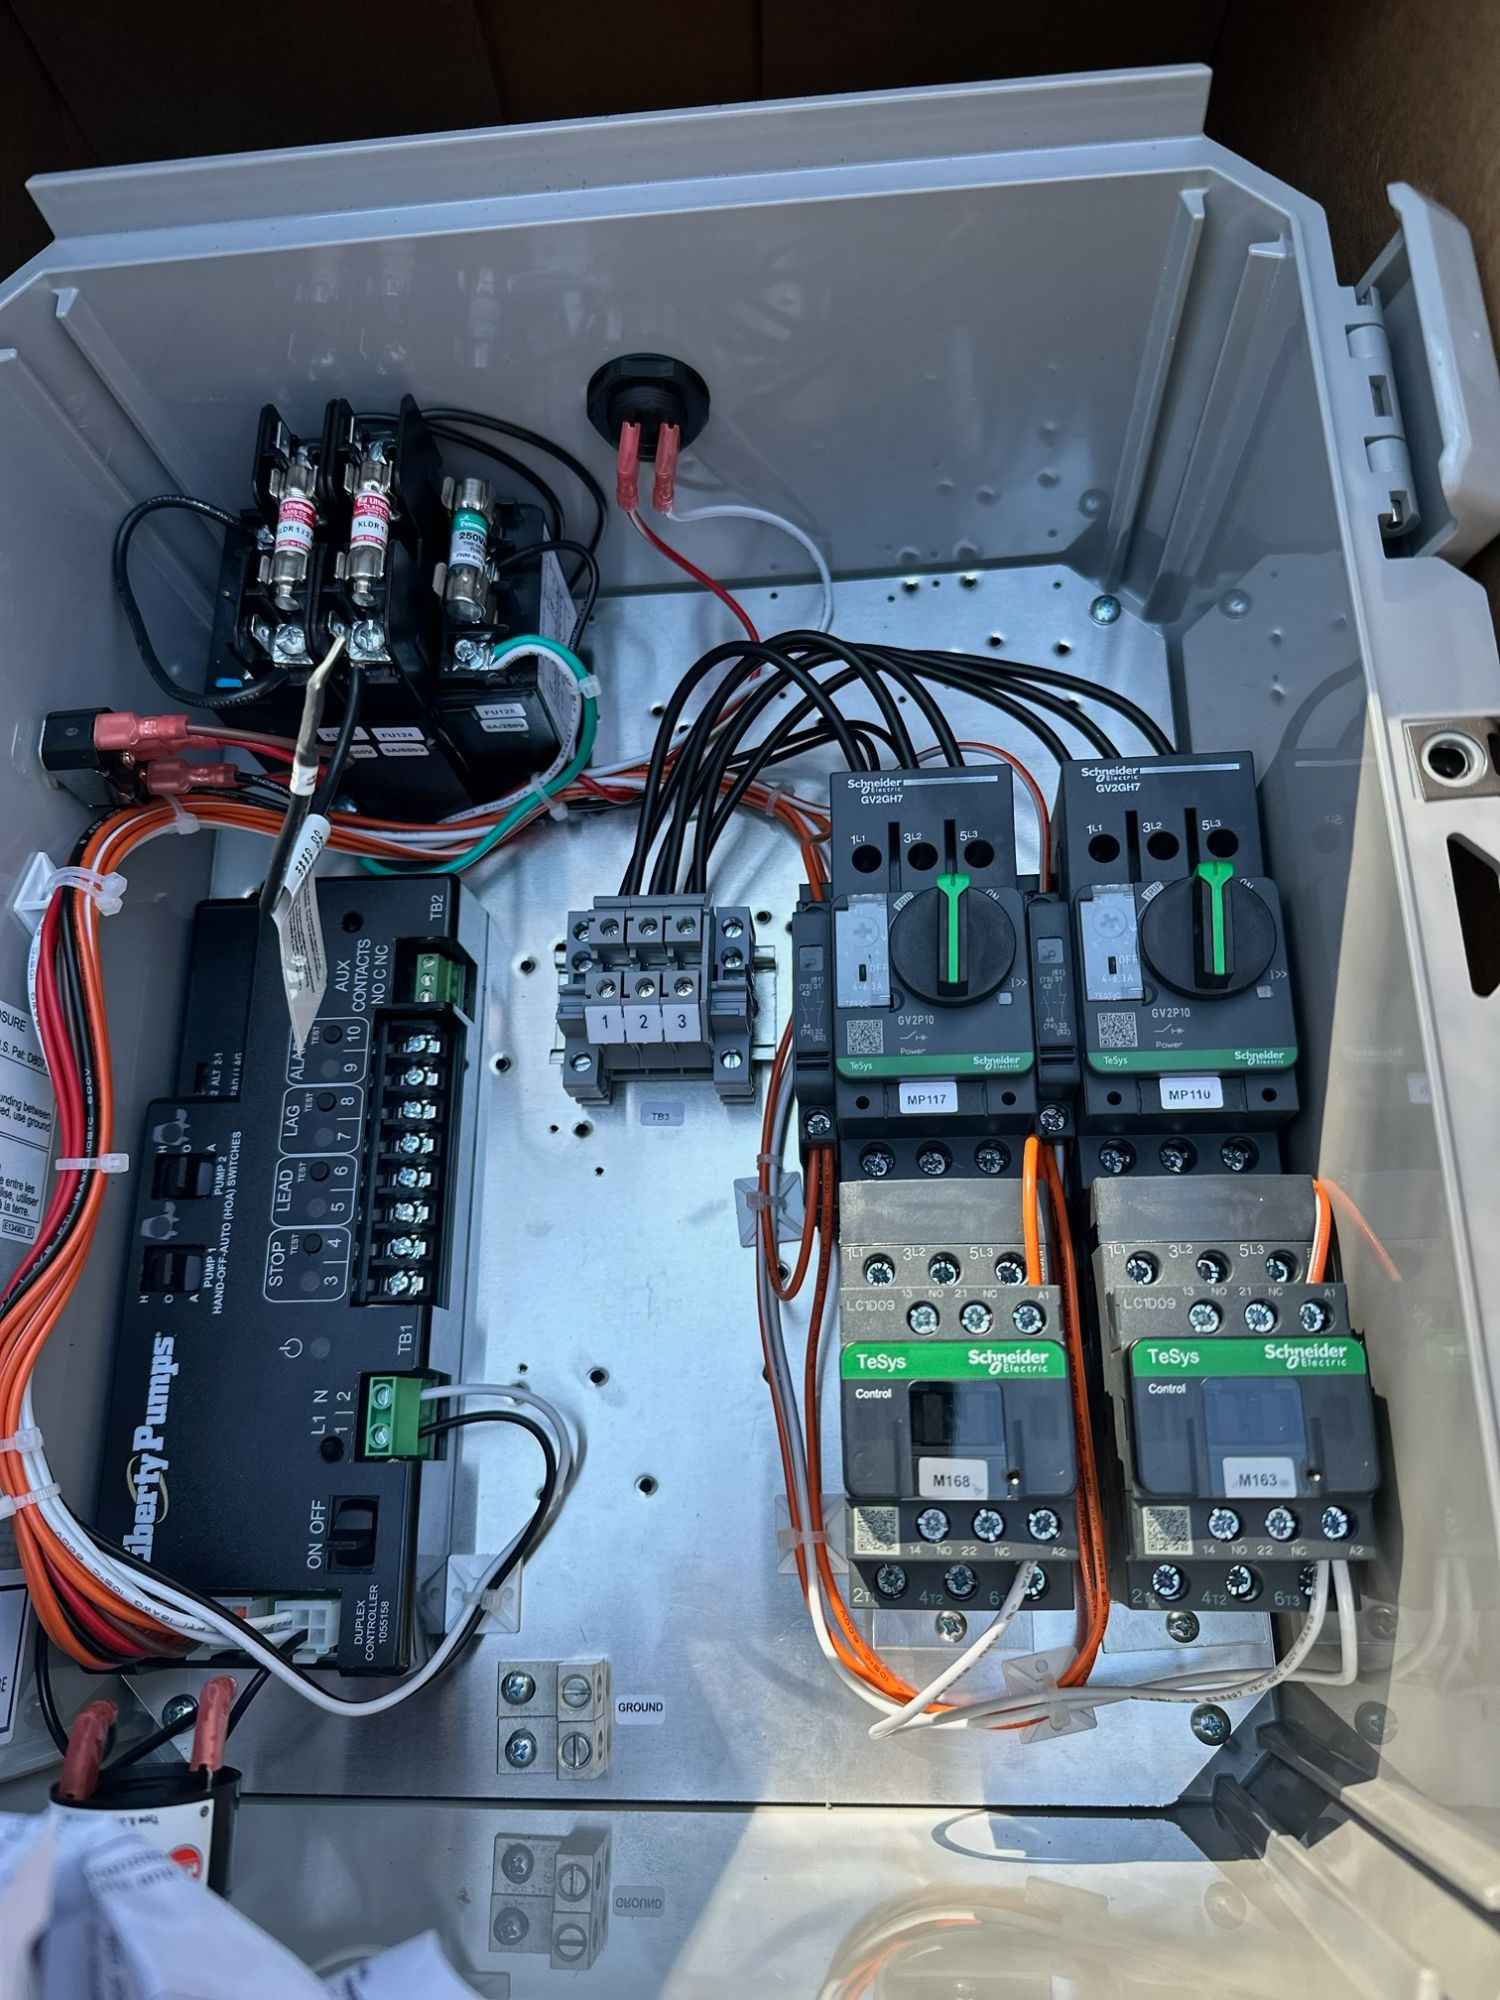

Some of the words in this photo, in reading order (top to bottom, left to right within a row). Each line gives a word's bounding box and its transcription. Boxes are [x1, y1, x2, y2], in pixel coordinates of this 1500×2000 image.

[1081, 766, 1138, 780] Schneider
[848, 779, 902, 792] Schneider
[1096, 783, 1141, 793] GV2GH7
[861, 794, 903, 804] GV2GH7
[1143, 882, 1163, 899] TRIP
[430, 895, 443, 921] TB2
[380, 945, 389, 970] NC
[335, 959, 351, 992] AUX
[352, 938, 371, 1012] CONTACTS
[379, 970, 387, 982] C
[371, 982, 385, 1004] NO
[1152, 1008, 1190, 1018] GV2P10
[0, 1010, 26, 1032] SURE
[602, 1015, 608, 1028] 1
[639, 1015, 648, 1028] 2
[678, 1015, 686, 1028] 3
[898, 1016, 935, 1025] GV2P10
[312, 1026, 320, 1045] TEST
[347, 1026, 360, 1042] 10
[973, 1056, 1020, 1068] Schneider
[1104, 1056, 1128, 1066] TeSys
[1235, 1050, 1284, 1062] Schneider
[344, 1063, 357, 1072] 9
[850, 1062, 872, 1071] TeSys
[212, 1070, 221, 1086] ALT
[305, 1092, 314, 1112] TEST
[341, 1096, 354, 1106] 8
[907, 1094, 946, 1105] MP117
[284, 1105, 300, 1136] LAG
[651, 1112, 670, 1121] TB3
[337, 1132, 351, 1141] 7
[183, 1144, 191, 1153] O
[207, 1144, 217, 1152] A
[227, 1131, 242, 1187] SWITCHES
[298, 1161, 307, 1182] TEST
[334, 1166, 348, 1176] 6
[214, 1165, 225, 1196] PUMP
[276, 1169, 293, 1212] LEAD
[224, 1190, 234, 1220] (HOA)
[331, 1202, 345, 1212] 5
[290, 1233, 300, 1255] TEST
[328, 1238, 341, 1247] 4
[212, 1221, 231, 1315] HAND-OFF-AUTO
[269, 1241, 285, 1287] STOP
[204, 1255, 216, 1288] PUMP
[324, 1276, 337, 1286] 3
[164, 1295, 173, 1303] O
[189, 1294, 199, 1303] A
[398, 1324, 412, 1355] TB1
[1147, 1349, 1200, 1367] TeSys
[1264, 1343, 1347, 1360] Schneider
[857, 1354, 906, 1372] TeSys
[968, 1350, 1049, 1367] Schneider
[1301, 1358, 1347, 1367] Electric
[1003, 1362, 1048, 1372] Electric
[132, 1335, 179, 1452] Pumps
[855, 1388, 892, 1399] Control
[1148, 1383, 1186, 1394] Control
[314, 1390, 328, 1403] N
[337, 1390, 351, 1401] 2
[312, 1415, 325, 1435] L1
[335, 1425, 348, 1434] 1
[933, 1475, 970, 1487] M168
[1239, 1474, 1277, 1486] M163
[311, 1500, 326, 1535] OFF
[55, 1532, 84, 1561] 600V
[307, 1543, 322, 1570] ON
[355, 1600, 365, 1646] DUPLEX
[365, 1583, 378, 1661] CONTROLLER
[379, 1600, 389, 1643] 1055158
[618, 1702, 663, 1713] GROUND
